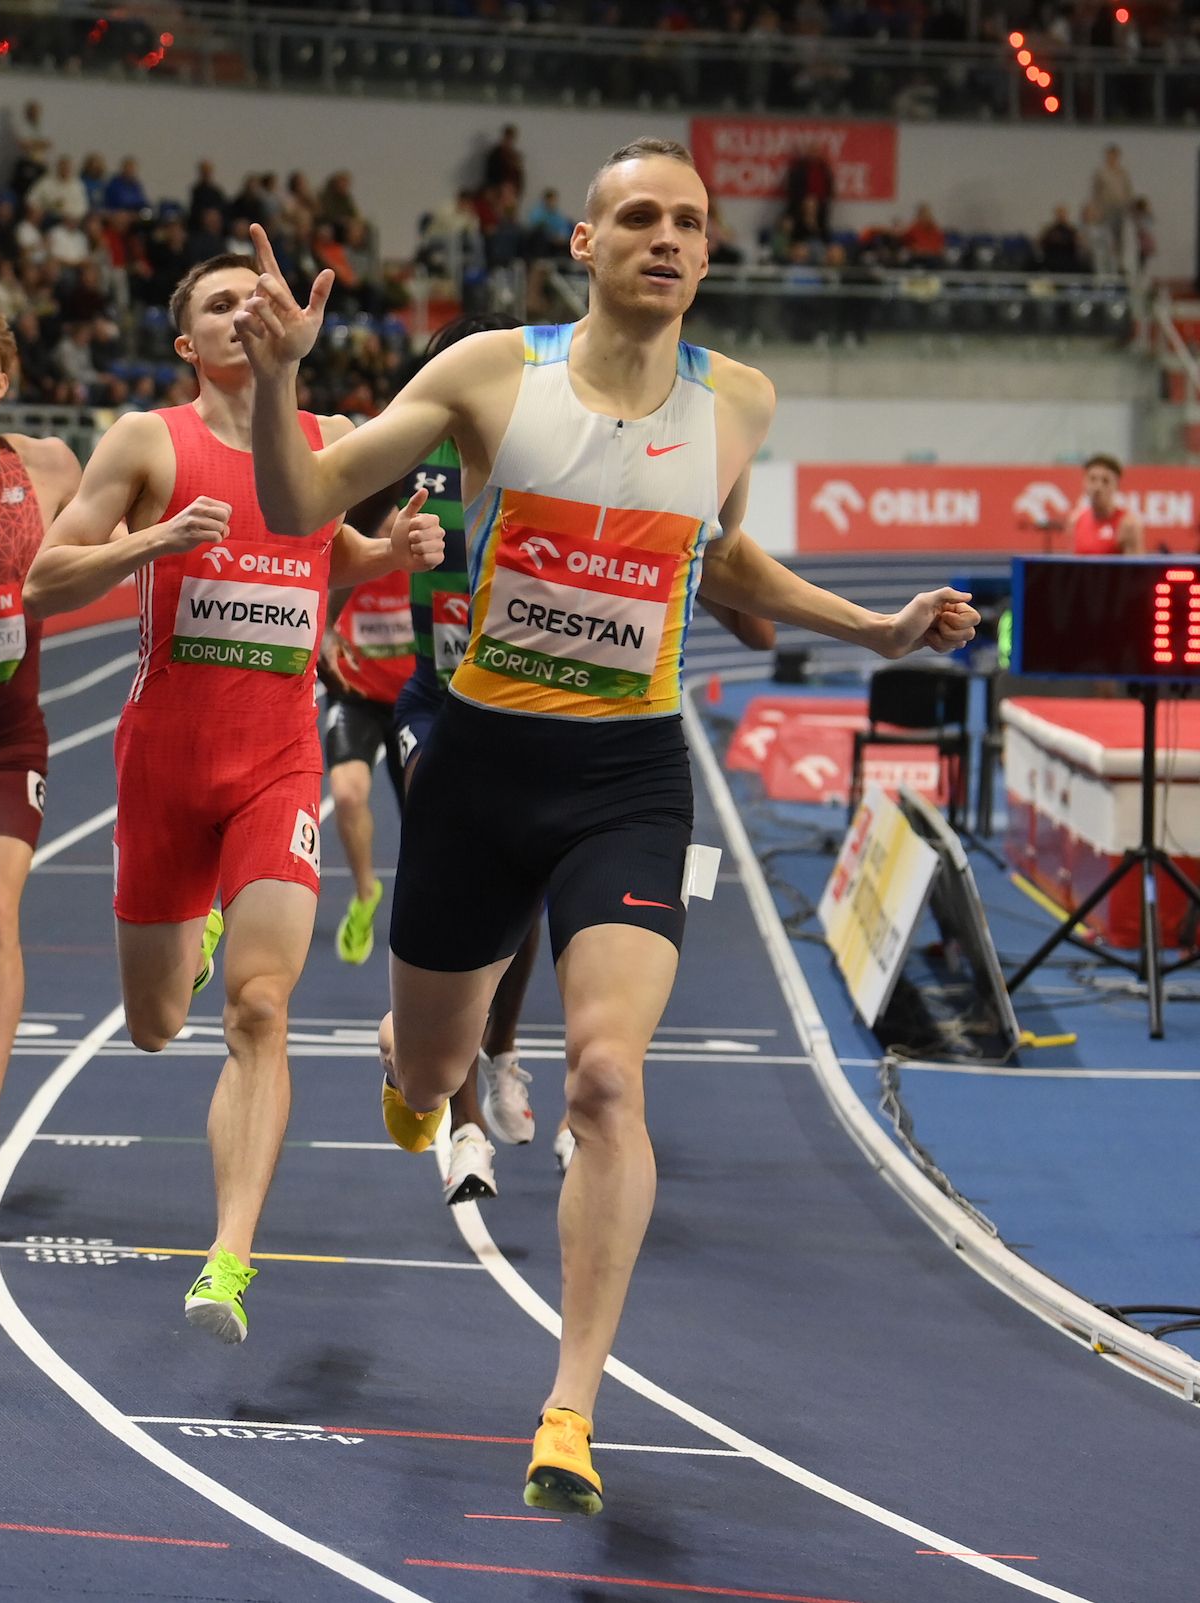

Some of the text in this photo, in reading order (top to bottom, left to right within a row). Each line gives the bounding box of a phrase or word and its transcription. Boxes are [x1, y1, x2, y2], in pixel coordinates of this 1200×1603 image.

[870, 488, 980, 527] ORLEN
[239, 554, 311, 577] ORLEN
[566, 551, 660, 587] ORLEN
[190, 598, 311, 630] WYDERKA
[507, 598, 645, 649] CRESTAN
[179, 643, 243, 664] TORUŃ
[248, 649, 273, 666] 26
[483, 645, 555, 681] TORUŃ
[558, 666, 590, 687] 26
[301, 822, 315, 854] 9
[178, 1425, 365, 1445] 4x200
